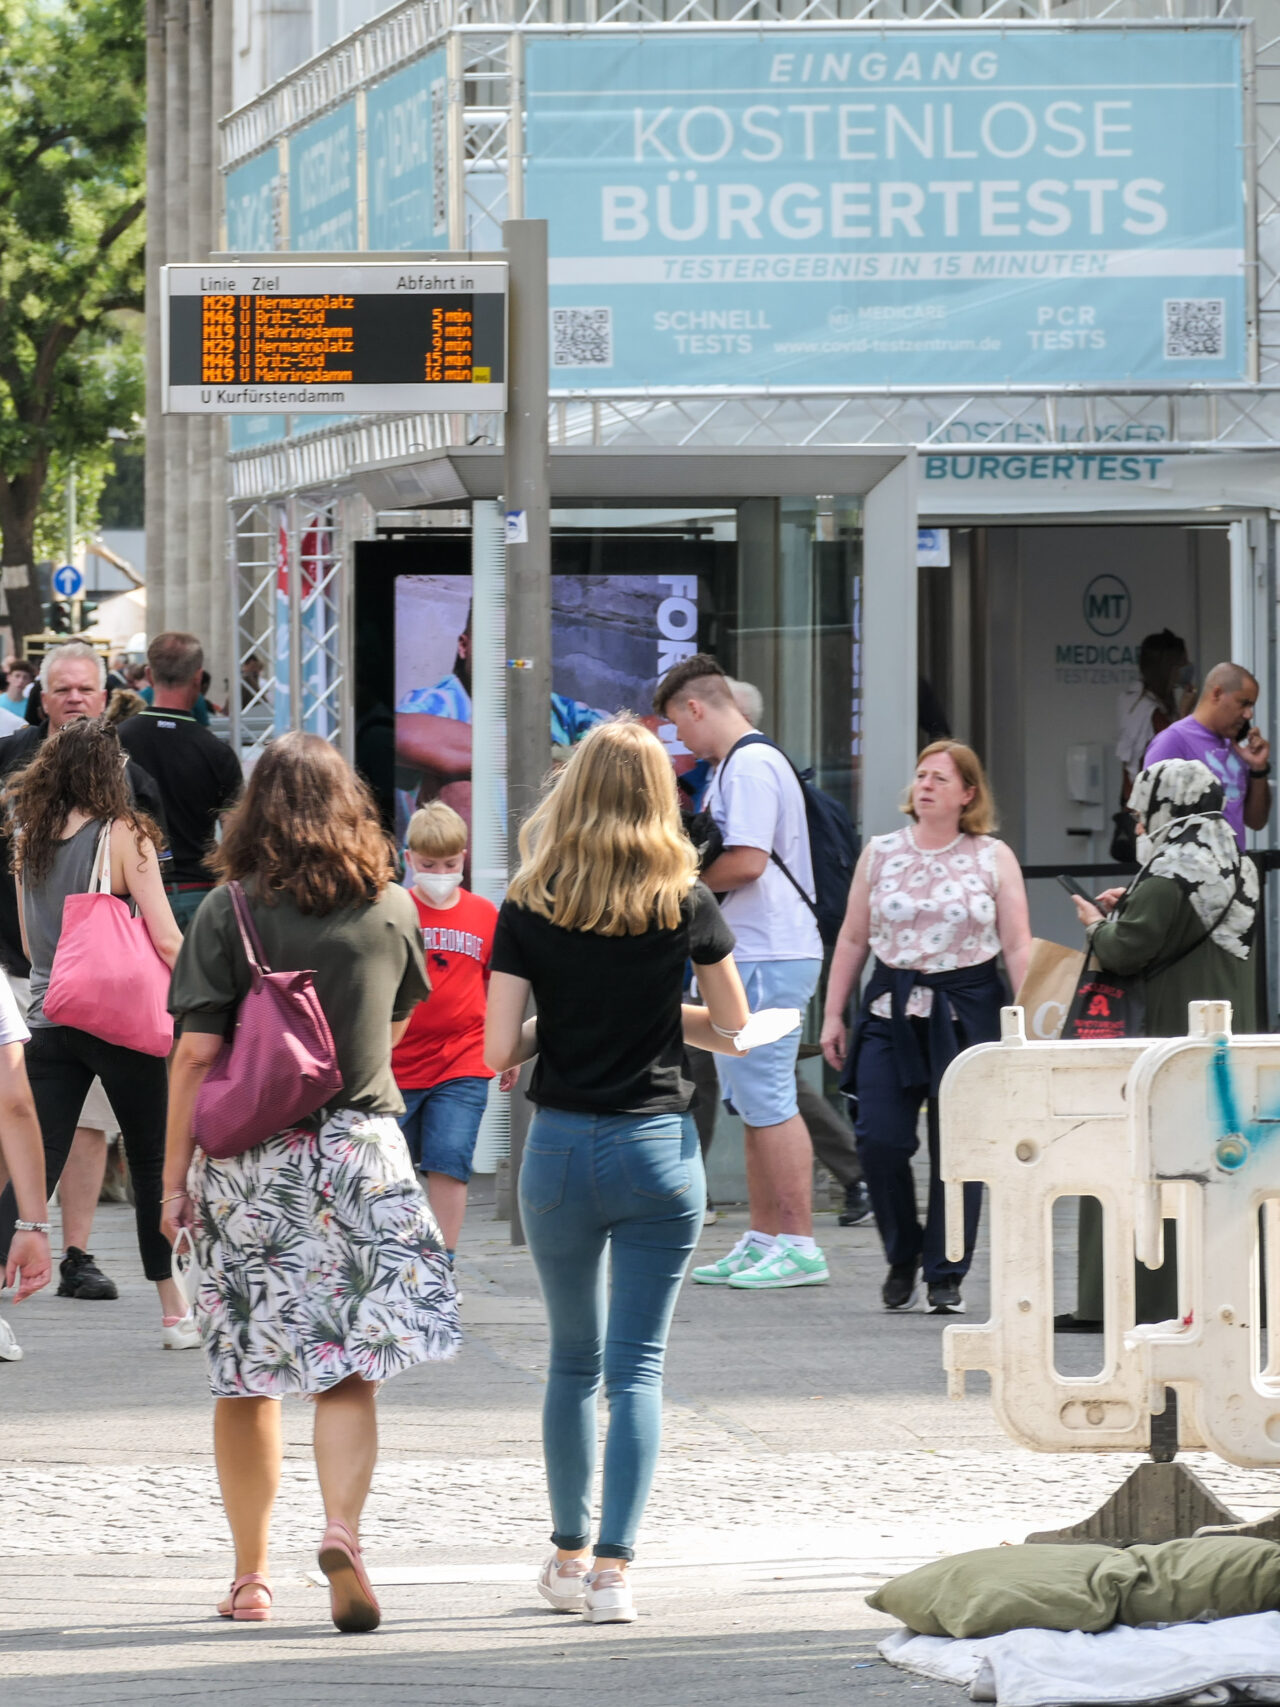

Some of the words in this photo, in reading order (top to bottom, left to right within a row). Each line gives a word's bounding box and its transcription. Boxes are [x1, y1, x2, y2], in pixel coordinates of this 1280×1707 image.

[769, 52, 1000, 84] EINGANG
[633, 100, 1134, 164] KOSTENLOSE
[602, 170, 1169, 243] BÜRGERTESTS
[662, 255, 880, 281] TESTERGEBNIS
[890, 256, 921, 278] IN
[932, 255, 961, 277] 15
[973, 252, 1110, 277] MINUTEN
[200, 277, 236, 291] Linie
[252, 277, 279, 291] Ziel
[396, 275, 456, 291] Abfahrt
[460, 276, 474, 290] in
[202, 296, 235, 309] M29
[255, 296, 354, 309] Hermannplatz
[202, 310, 235, 324] M46
[255, 310, 325, 324] Britz-Süd
[445, 309, 471, 323] min
[653, 311, 771, 332] SCHNELL
[1037, 305, 1095, 327] PCR
[202, 325, 235, 338] M19
[255, 325, 353, 339] Mehringdamm
[445, 323, 471, 337] min
[1027, 329, 1106, 351] TESTS
[202, 339, 235, 353] M29
[255, 339, 354, 353] Hermannplatz
[445, 338, 471, 351] min
[673, 334, 753, 355] TESTS
[202, 354, 235, 367] M46
[255, 354, 325, 367] Britz-Süd
[425, 353, 443, 366] 15
[445, 353, 471, 366] min
[202, 368, 235, 382] M19
[255, 368, 353, 382] Mehringdamm
[445, 367, 471, 381] min
[201, 390, 211, 403] U
[218, 389, 345, 404] Kurfürstendamm
[1089, 595, 1125, 619] MT
[1056, 645, 1141, 665] MEDICA
[421, 927, 484, 960] RCROMBIE
